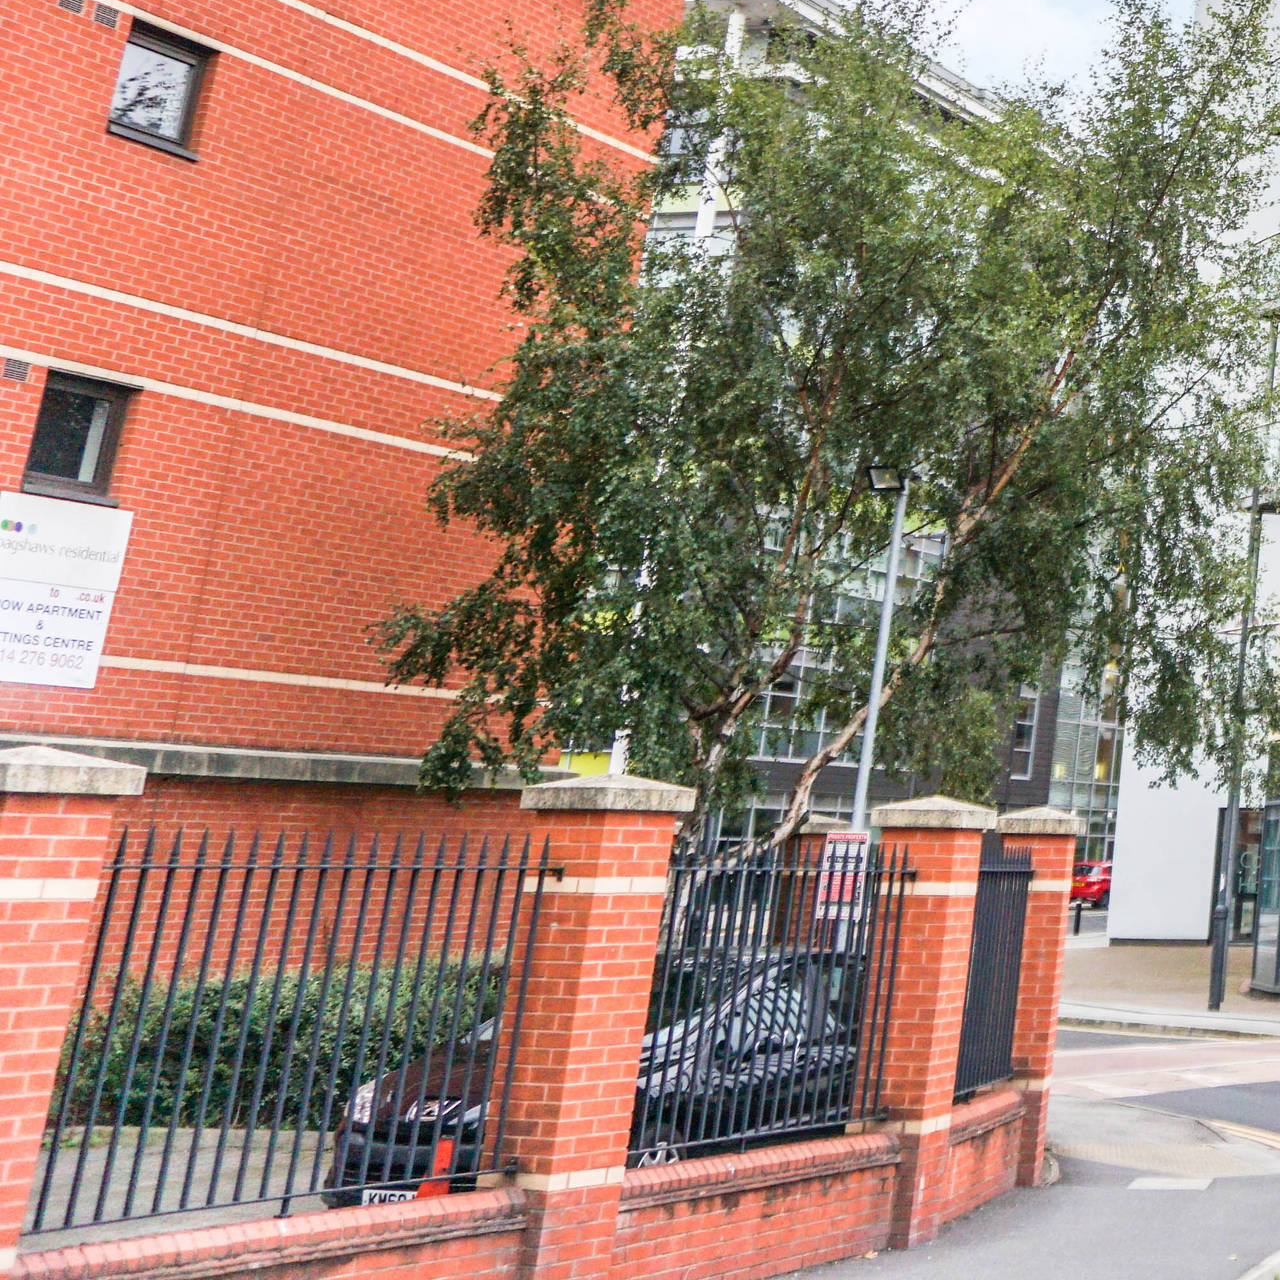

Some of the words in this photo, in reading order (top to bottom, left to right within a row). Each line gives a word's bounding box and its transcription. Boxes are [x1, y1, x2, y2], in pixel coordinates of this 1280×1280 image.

[59, 545, 119, 563] residential
[27, 603, 102, 620] APARTMENT
[36, 620, 43, 630] &
[43, 636, 94, 651] CENTRE
[19, 650, 45, 665] 276
[50, 653, 83, 669] 9062
